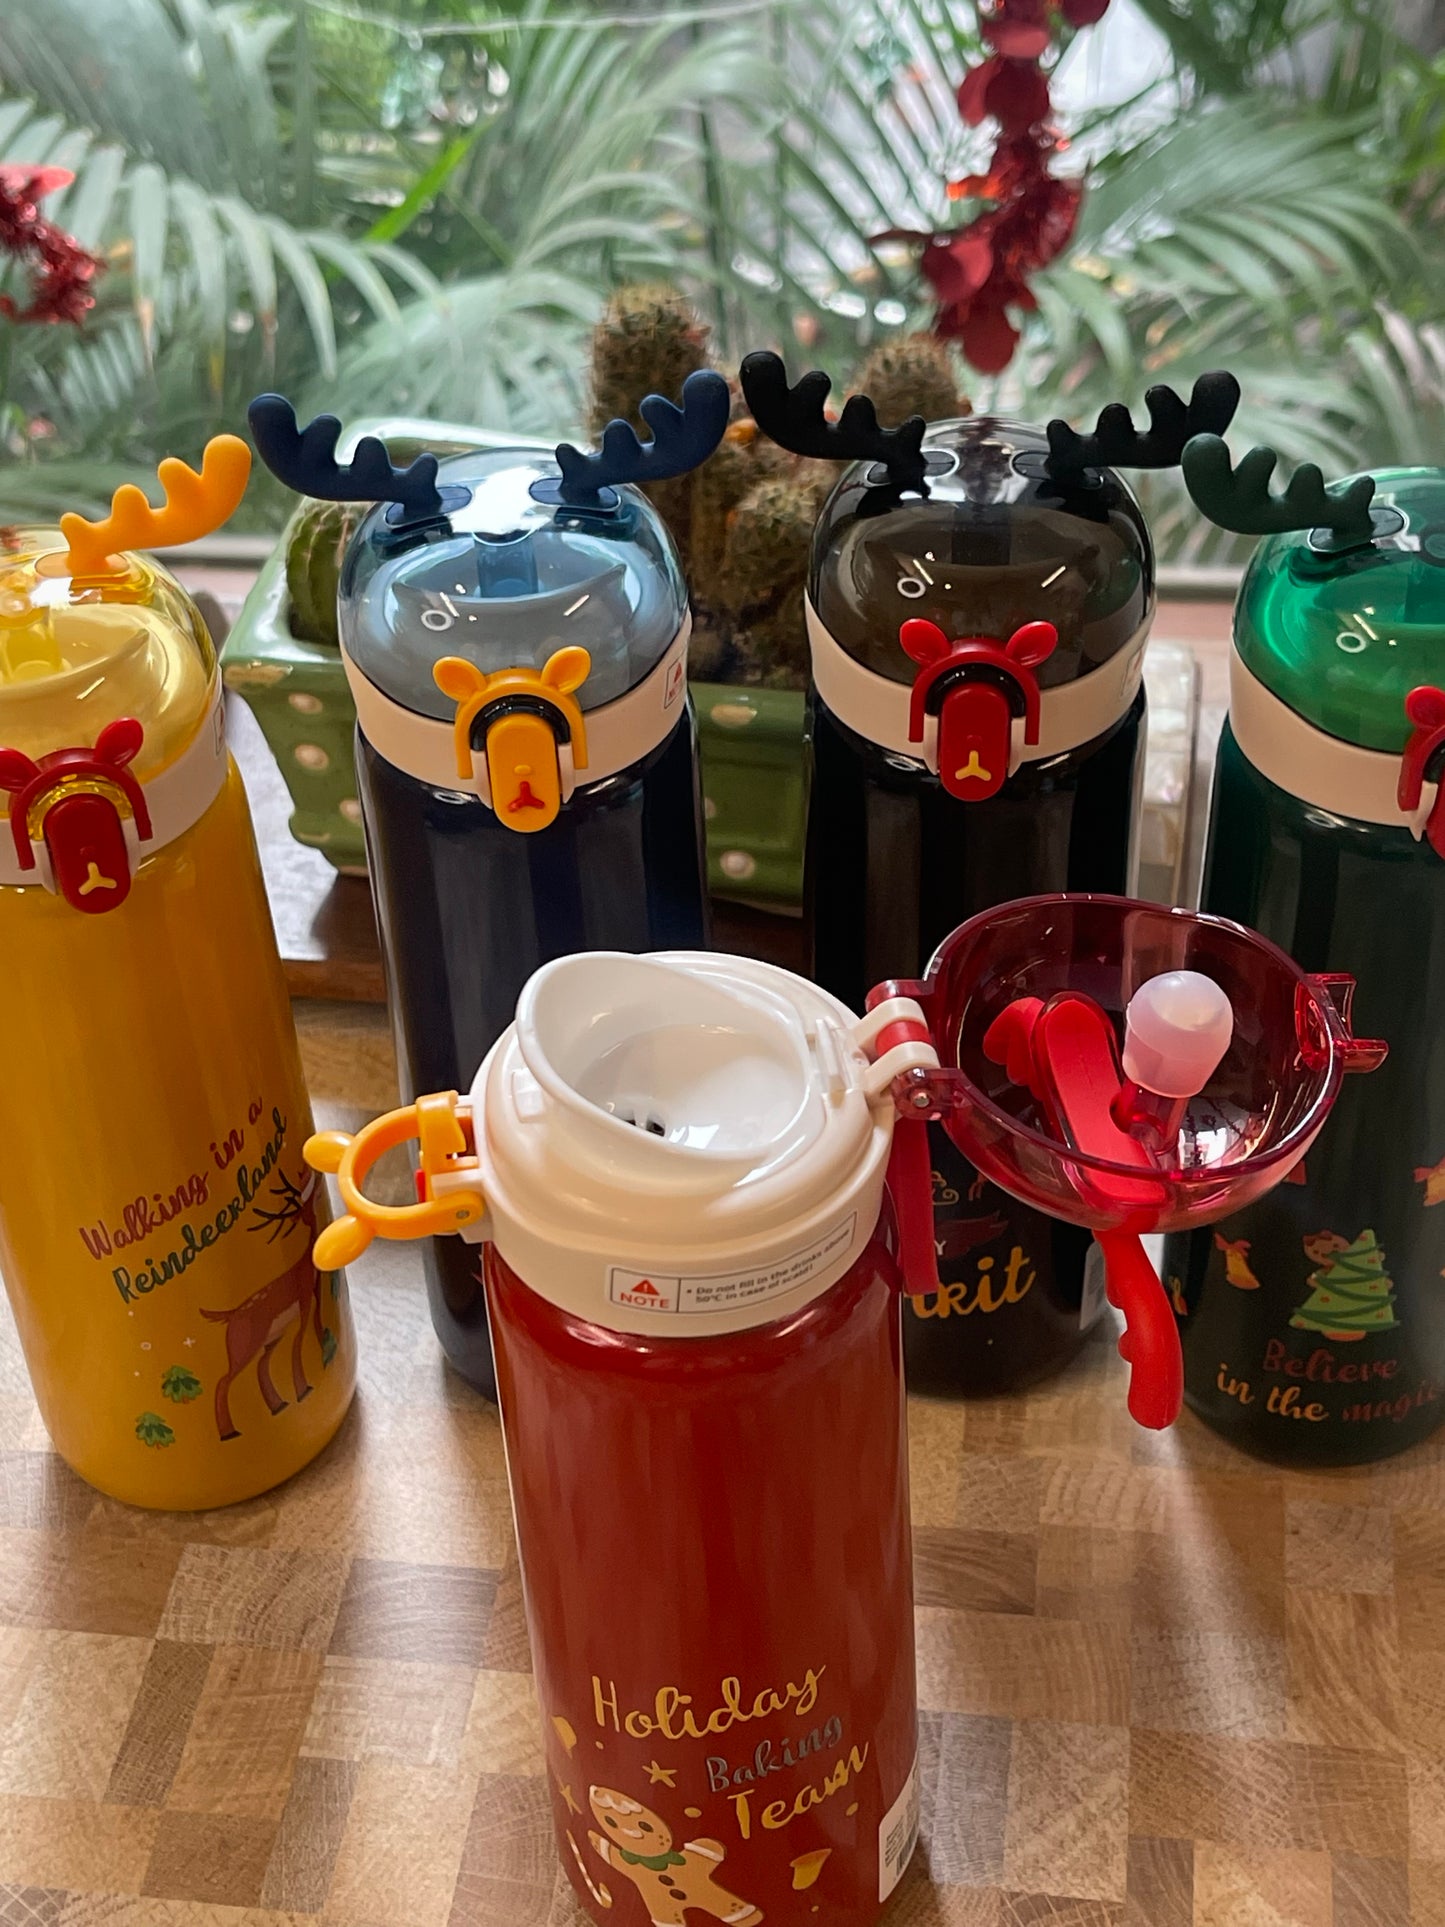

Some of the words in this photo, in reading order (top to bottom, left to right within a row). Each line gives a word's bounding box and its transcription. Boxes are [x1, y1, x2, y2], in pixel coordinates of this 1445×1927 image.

[80, 1170, 210, 1261] Walking
[211, 1128, 244, 1171] in
[248, 1097, 263, 1125] a
[112, 1106, 288, 1304] Reindeerland
[619, 1292, 670, 1309] NOTE
[696, 1286, 714, 1295] Do
[715, 1283, 736, 1293] not
[739, 1279, 754, 1289] fill
[757, 1276, 769, 1285] in
[770, 1268, 789, 1281] the
[1216, 1362, 1256, 1405] in
[1266, 1385, 1329, 1422] the
[1262, 1338, 1398, 1383] Believe
[591, 1664, 827, 1740] Holiday
[705, 1715, 843, 1793] Baking
[727, 1741, 869, 1840] Team
